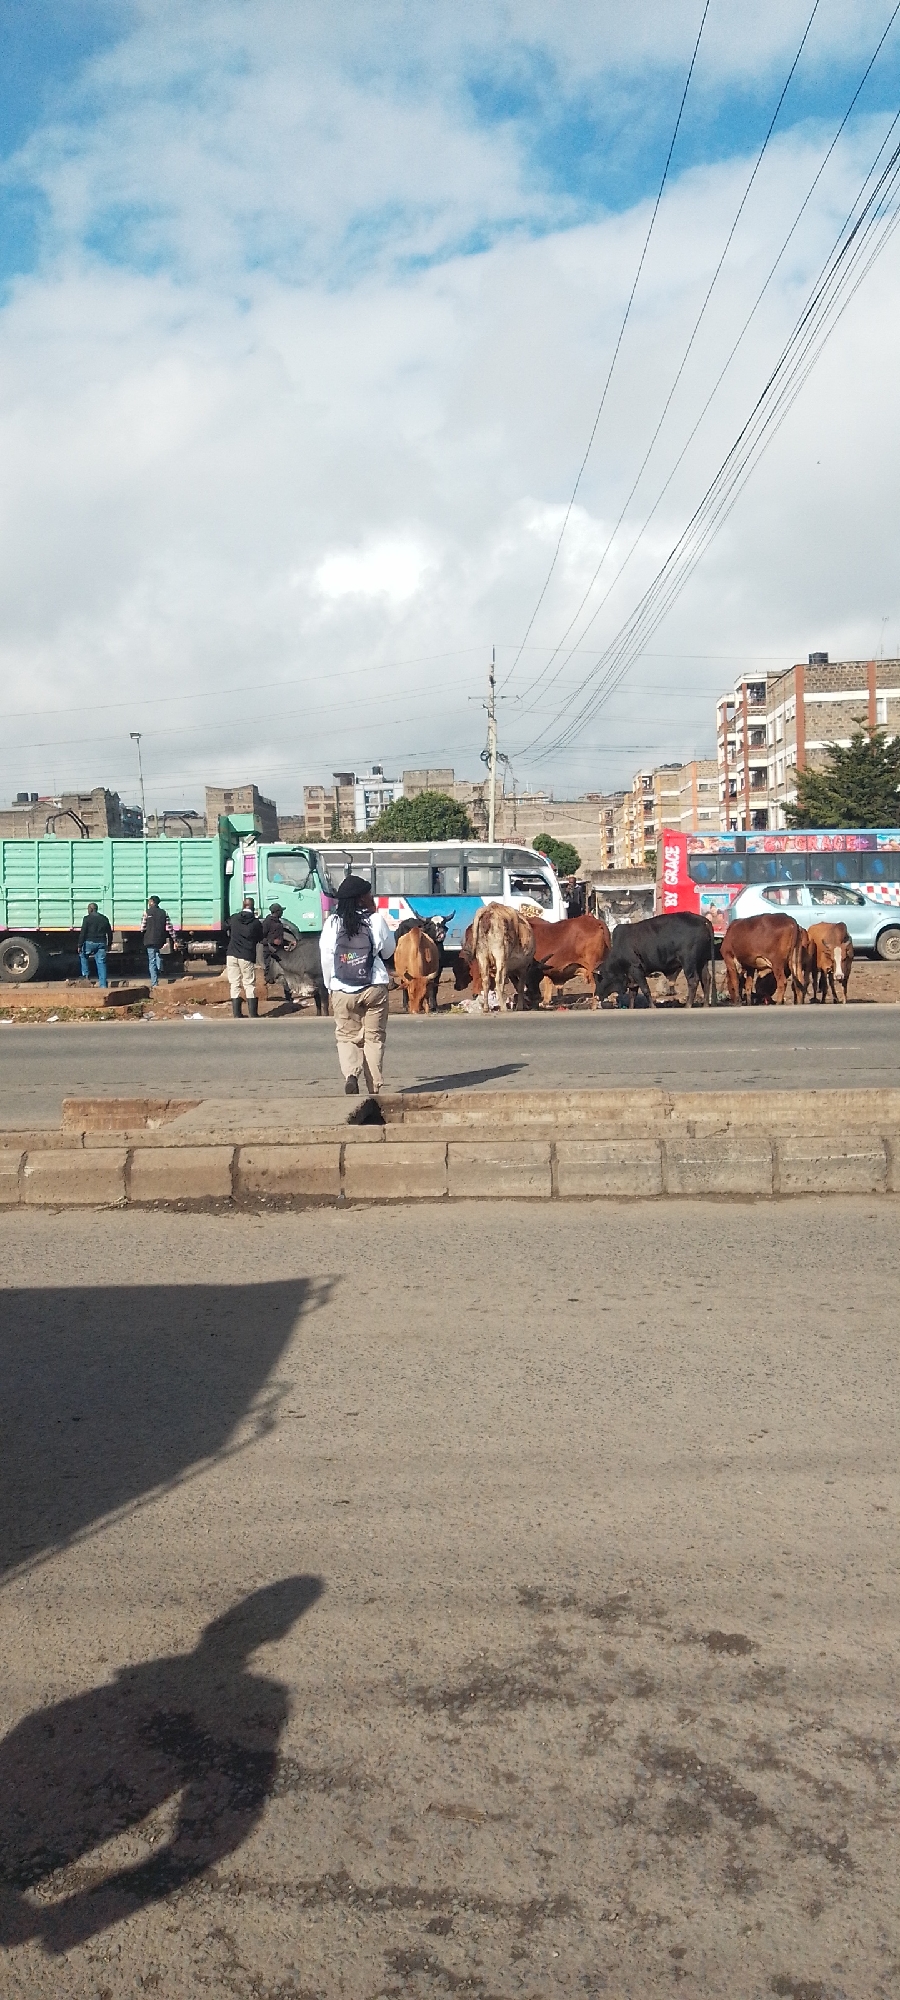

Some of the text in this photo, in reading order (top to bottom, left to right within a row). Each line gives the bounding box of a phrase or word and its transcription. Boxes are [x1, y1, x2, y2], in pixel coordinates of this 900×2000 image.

[795, 835, 857, 851] GRACE
[664, 846, 680, 907] BY GRACE
